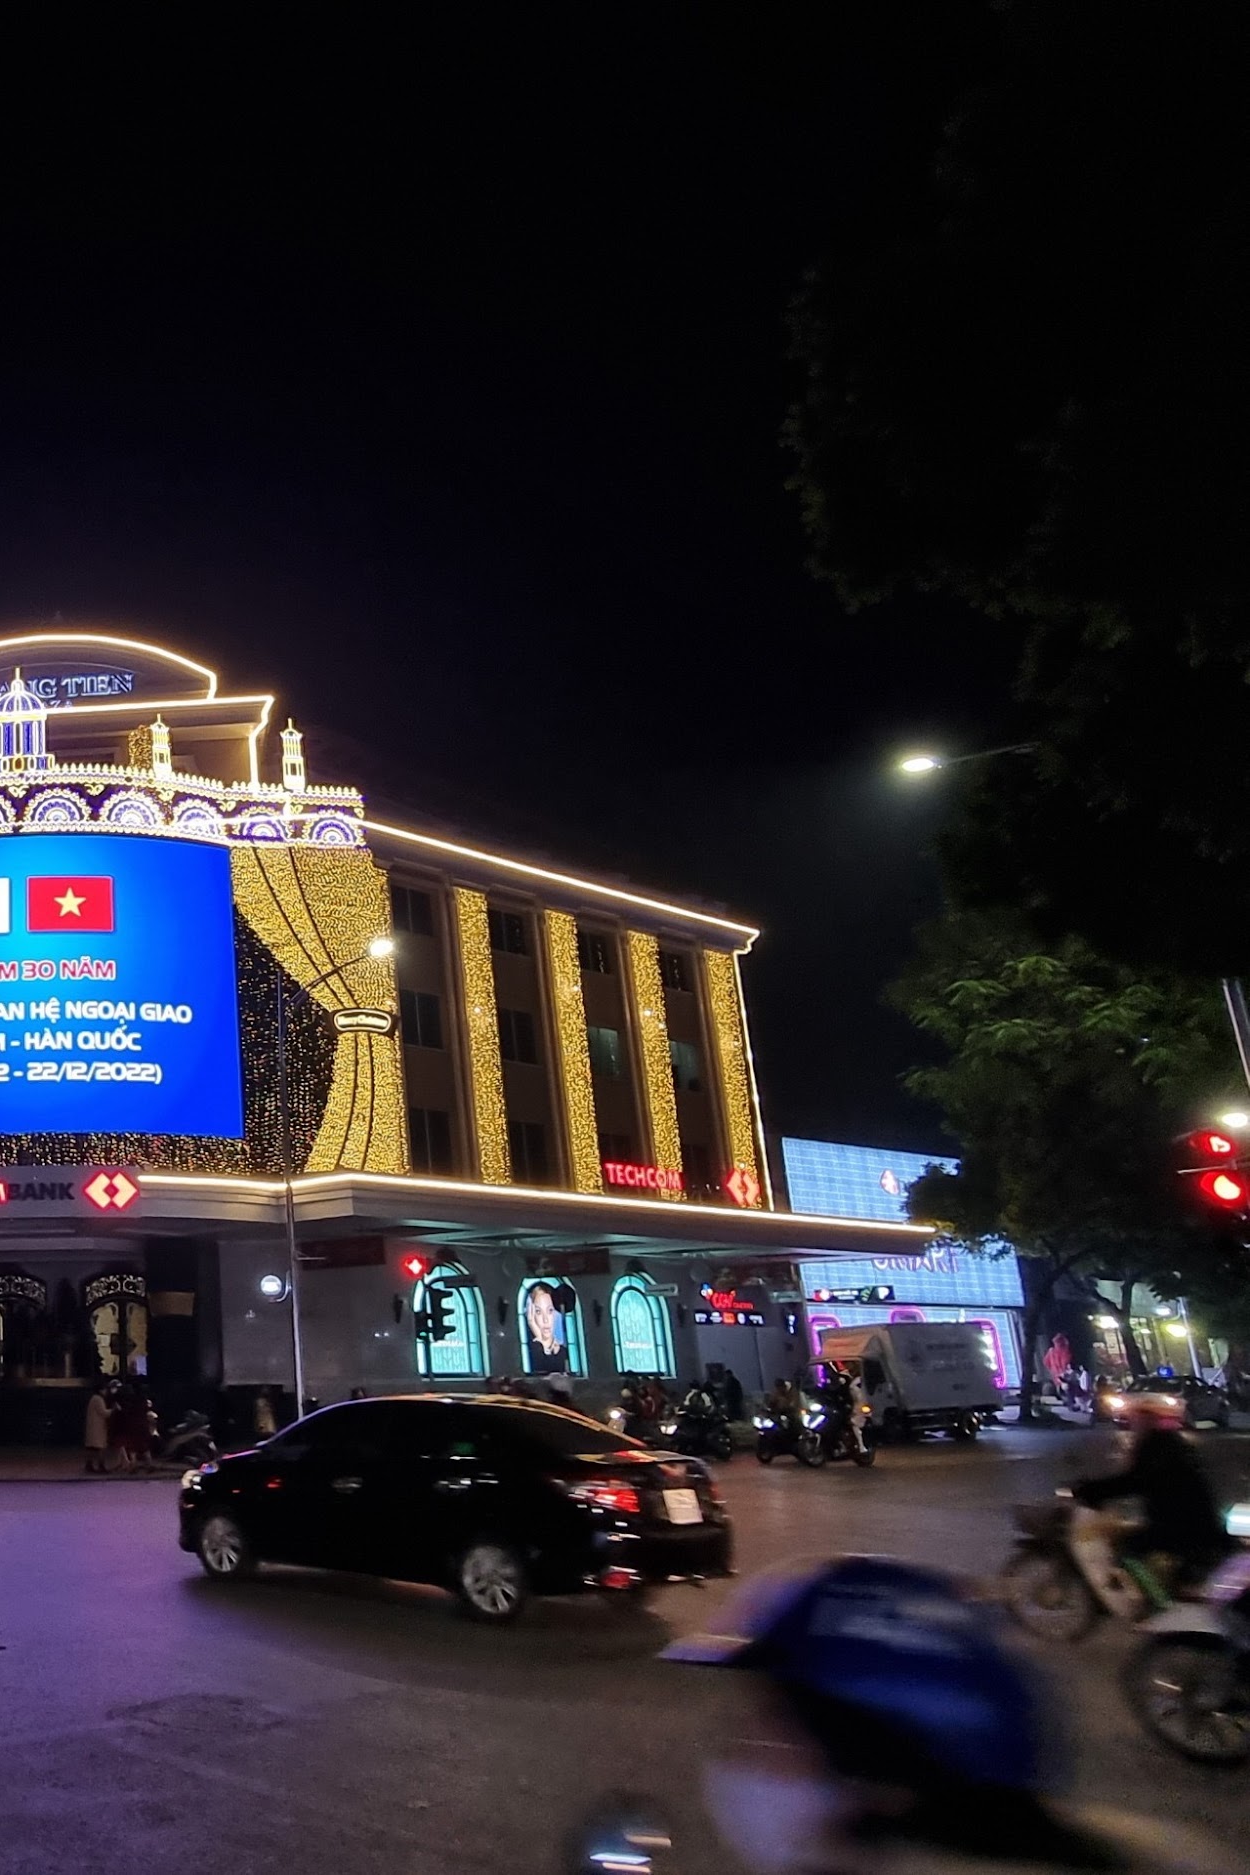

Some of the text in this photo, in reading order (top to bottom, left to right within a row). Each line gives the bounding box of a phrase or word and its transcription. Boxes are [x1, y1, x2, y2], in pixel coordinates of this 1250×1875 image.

[61, 673, 134, 697] TIEN
[23, 960, 55, 980] 30
[60, 956, 116, 980] NĂM
[30, 997, 60, 1024] HỆ
[65, 1001, 136, 1024] NGOẠI
[139, 1002, 193, 1024] GIAO
[24, 1027, 73, 1050] HÀN
[77, 1024, 142, 1051] QUỐC
[26, 1061, 163, 1085] 22/12/2022)
[604, 1162, 683, 1190] TECHCOM
